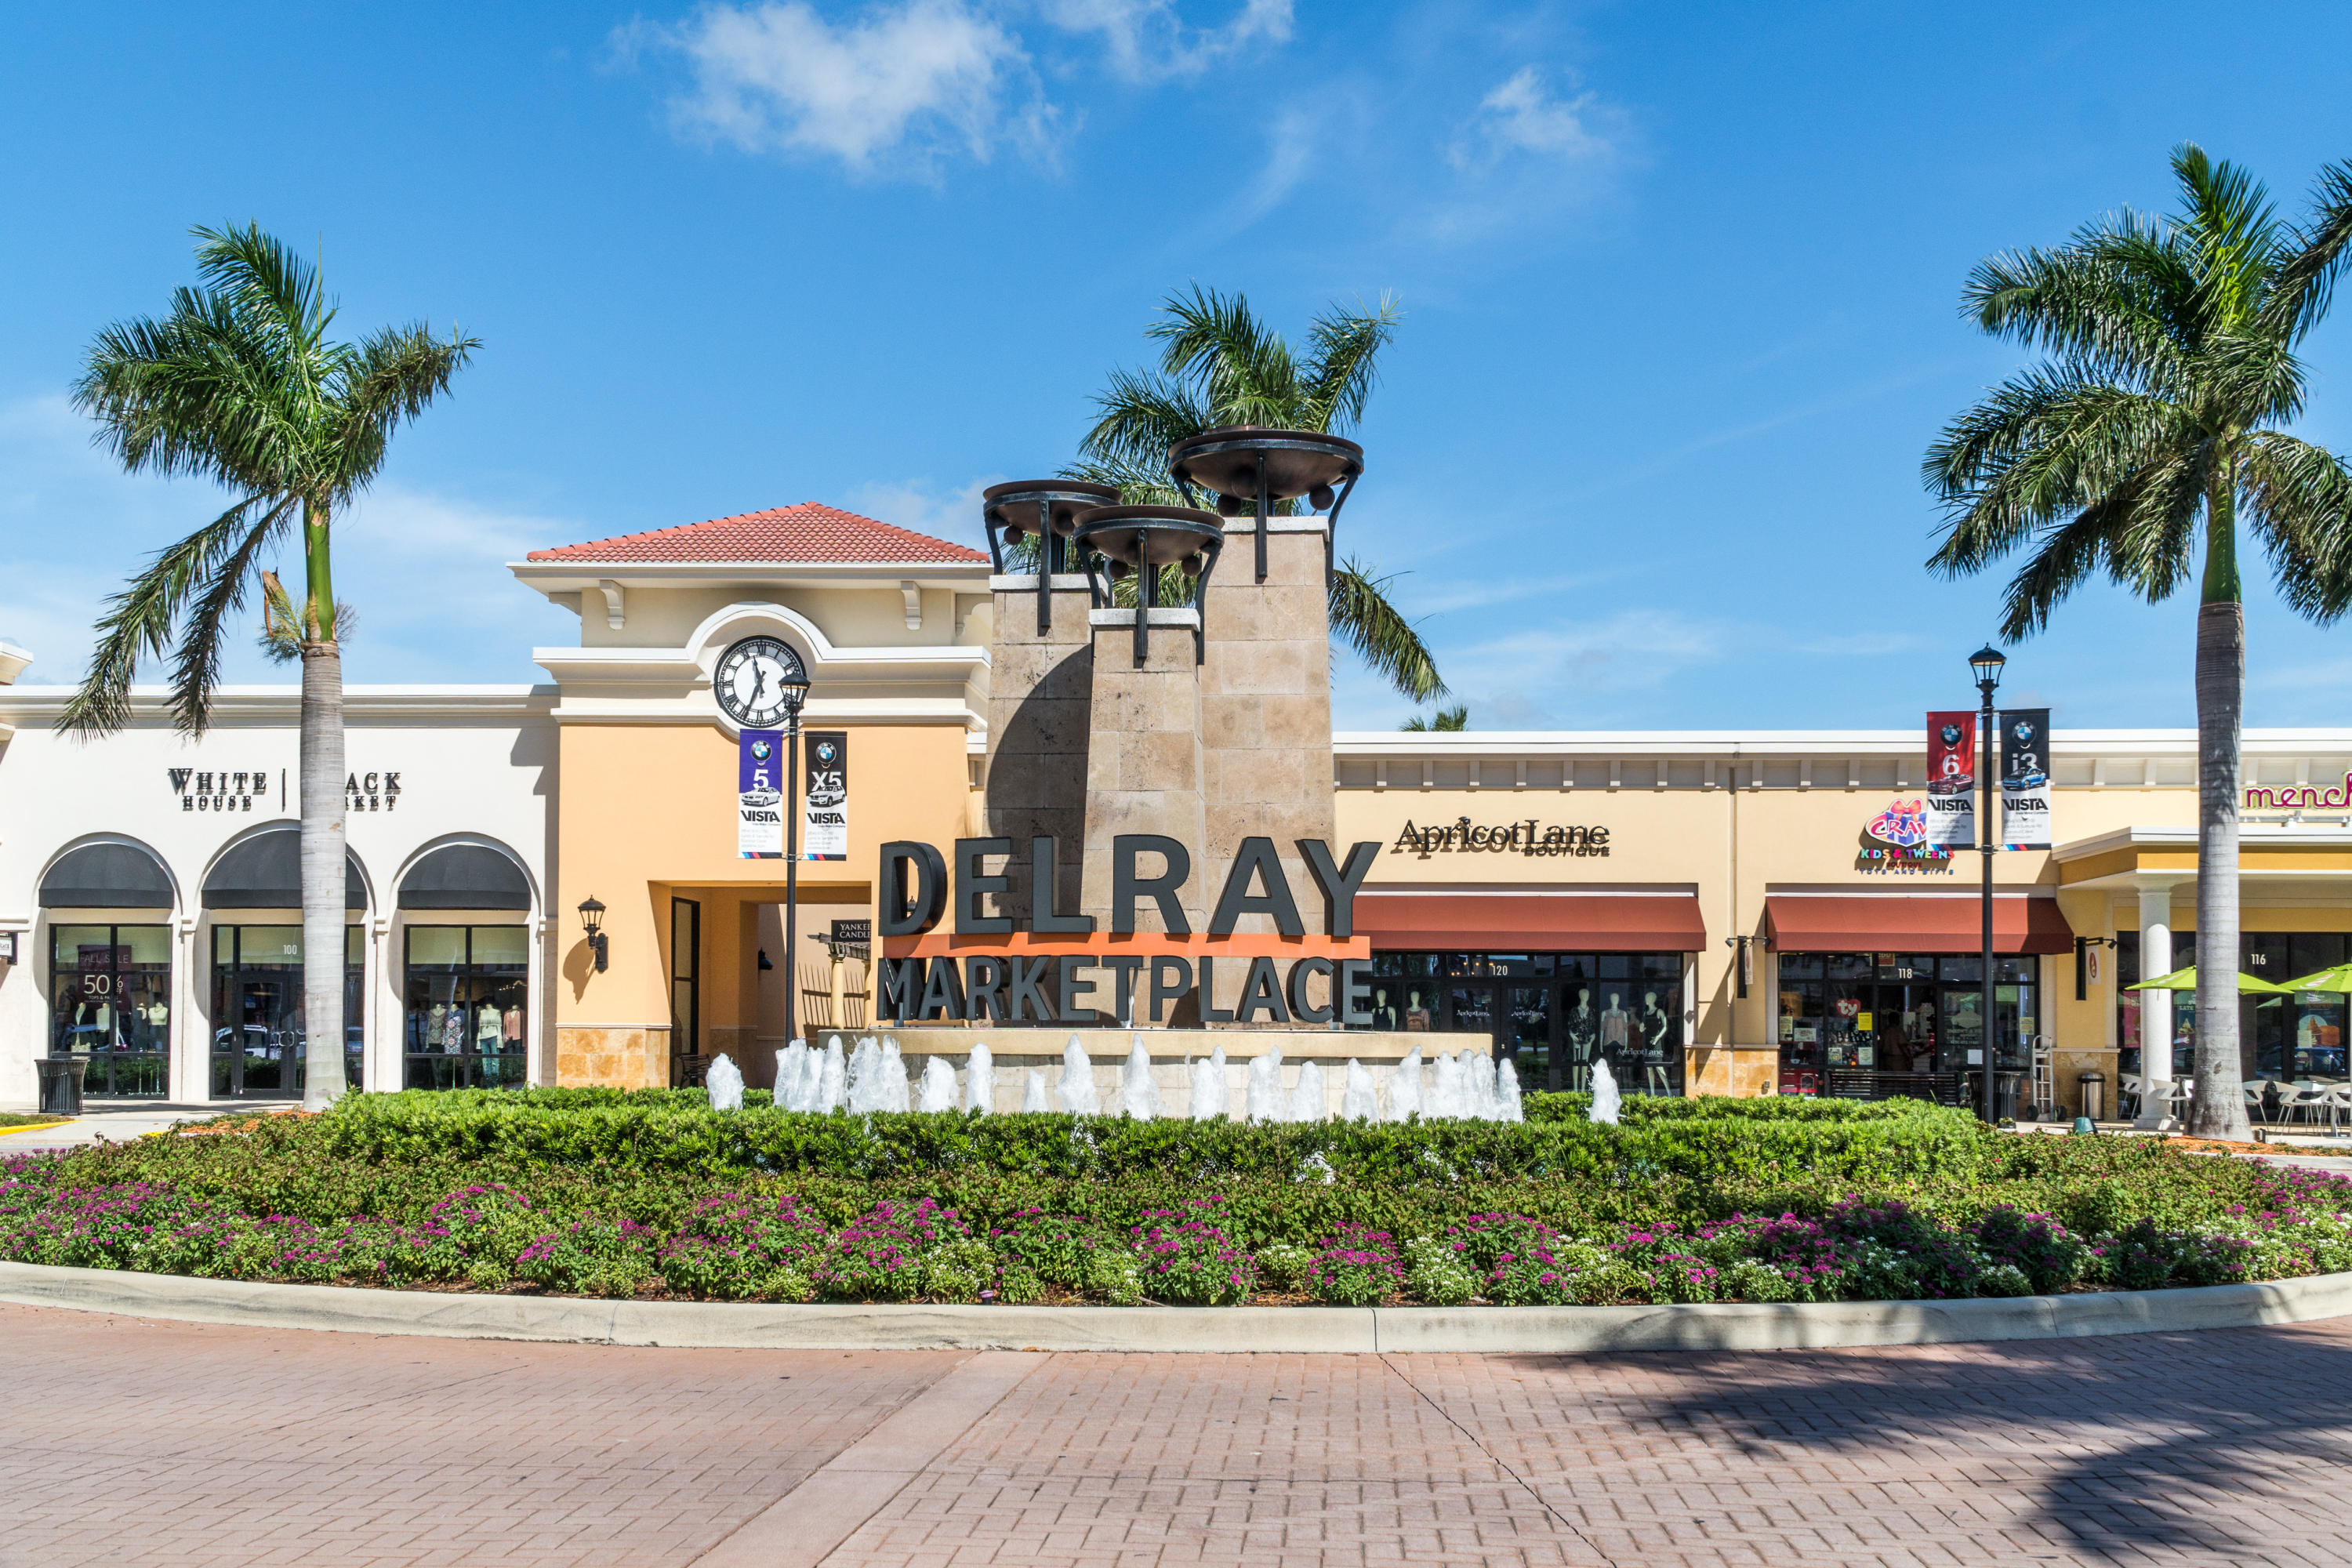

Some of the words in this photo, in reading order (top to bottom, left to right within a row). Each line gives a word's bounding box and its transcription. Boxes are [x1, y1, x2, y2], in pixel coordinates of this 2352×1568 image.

[1942, 754, 1960, 775] 6
[2012, 753, 2038, 772] i3
[168, 768, 267, 791] WHITE
[345, 771, 401, 790] ACK
[753, 768, 769, 789] 5
[811, 771, 842, 792] X5
[182, 795, 252, 808] HOUSE
[1927, 799, 1973, 811] VISTA
[2002, 798, 2049, 811] VISTA
[740, 810, 781, 822] VISTA
[807, 812, 846, 824] VISTA
[1871, 820, 1927, 837] CRAV
[1524, 846, 1610, 857] BOUTIQUE
[1860, 849, 1891, 859] KIDS
[1893, 849, 1902, 858] &
[1906, 849, 1955, 860] TWEENS
[878, 834, 1384, 938] DELRAY
[283, 944, 298, 955] 100
[81, 953, 101, 964] FALL
[105, 953, 129, 964] SLE
[2251, 953, 2267, 965] 116
[1492, 965, 1508, 976] 120
[1898, 967, 1913, 979] 118
[83, 975, 124, 995] 50%
[877, 954, 1374, 1025] MARKETPLACE
[1837, 1000, 1858, 1017] ty
